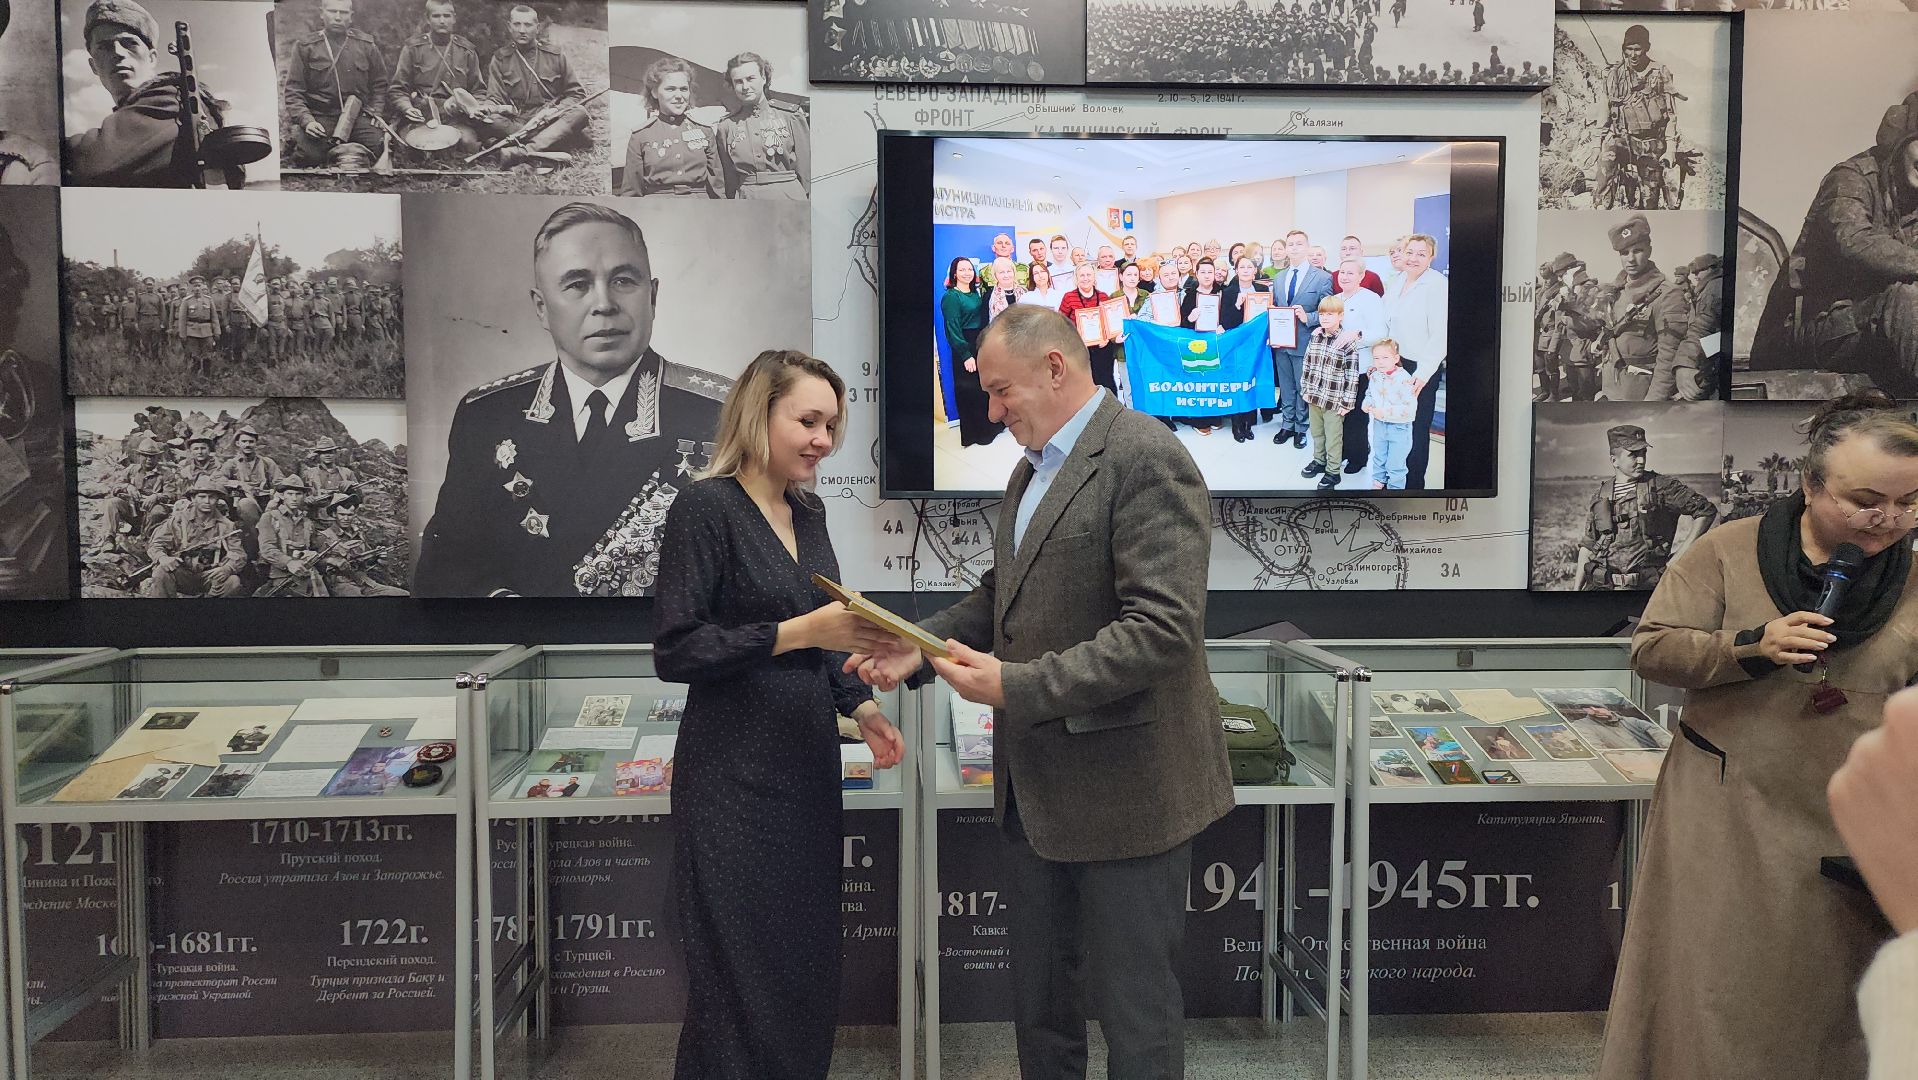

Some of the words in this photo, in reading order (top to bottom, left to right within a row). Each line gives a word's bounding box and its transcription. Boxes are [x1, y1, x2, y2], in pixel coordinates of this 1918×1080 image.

[1035, 103, 1076, 114] Вышний
[1082, 104, 1124, 114] Волочек
[914, 108, 974, 127] ФРОНТ
[1302, 117, 1344, 128] Калязин
[1148, 376, 1257, 393] ВОЛОНТЕРЫ
[1176, 396, 1233, 408] ИСТРЫ
[821, 475, 876, 486] СМОЛЕНСК
[947, 501, 980, 509] Гродок
[949, 517, 977, 526] Еьня
[1433, 512, 1465, 523] Пруды
[956, 815, 995, 823] полови
[250, 819, 413, 844] 1710-1713гг.
[598, 837, 636, 849] война.
[219, 873, 262, 885] Россия
[331, 871, 360, 882] Азов
[374, 869, 445, 882] Запорожье.
[339, 918, 429, 946] 1722г.
[972, 925, 1009, 936] Кавка
[1437, 935, 1488, 949] война
[327, 955, 398, 969] Персидский
[401, 955, 437, 965] поход.
[564, 950, 616, 963] Турцией.
[205, 963, 239, 973] война.
[1412, 962, 1477, 983] народа.
[310, 975, 350, 988] Турция
[352, 974, 405, 987] признала
[408, 972, 435, 985] Баку
[315, 989, 369, 1004] Дербент
[386, 986, 437, 999] Россией.
